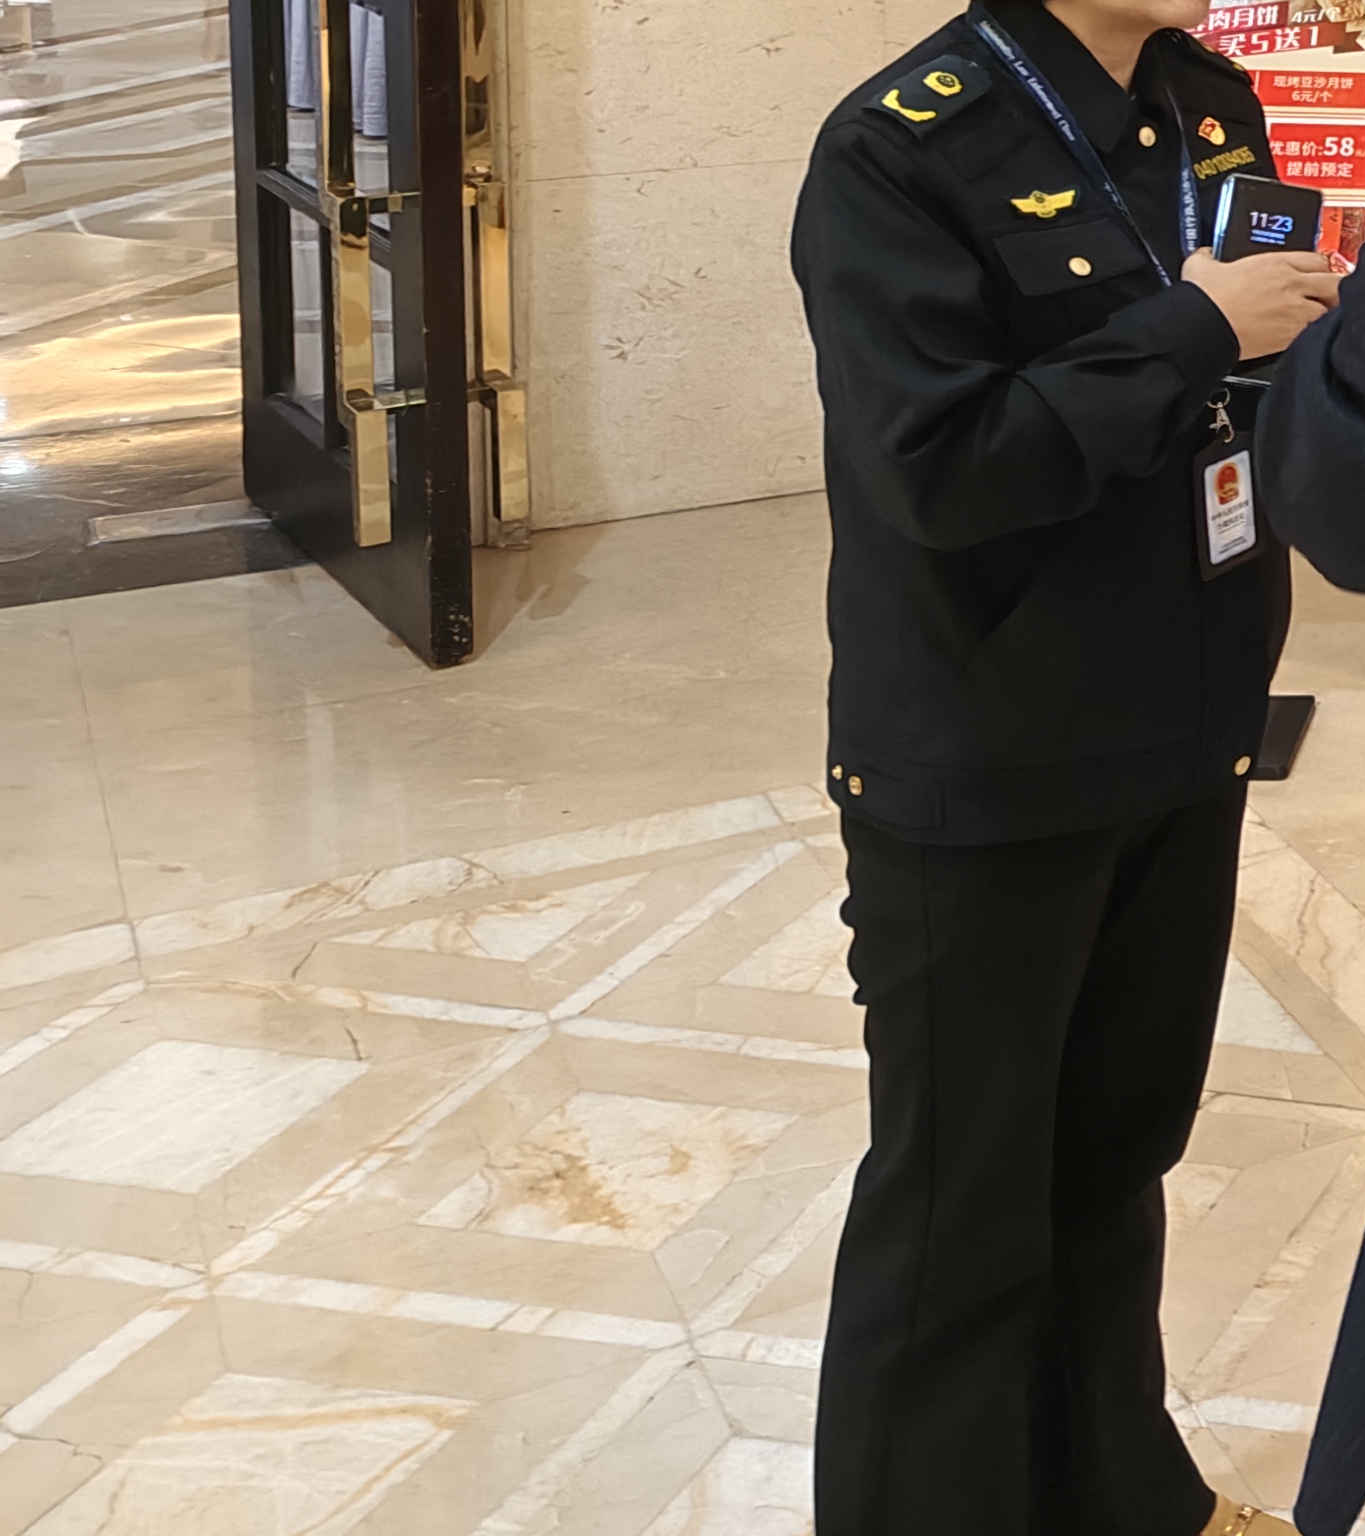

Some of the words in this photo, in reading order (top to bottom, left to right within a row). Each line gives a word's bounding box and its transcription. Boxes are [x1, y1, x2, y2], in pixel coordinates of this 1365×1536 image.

[1219, 26, 1319, 56] 买5送1
[1273, 75, 1353, 90] 现烤豆沙月饼
[1291, 90, 1333, 103] 6元/个
[1285, 161, 1354, 178] 提前预定
[1249, 211, 1294, 233] 11:23
